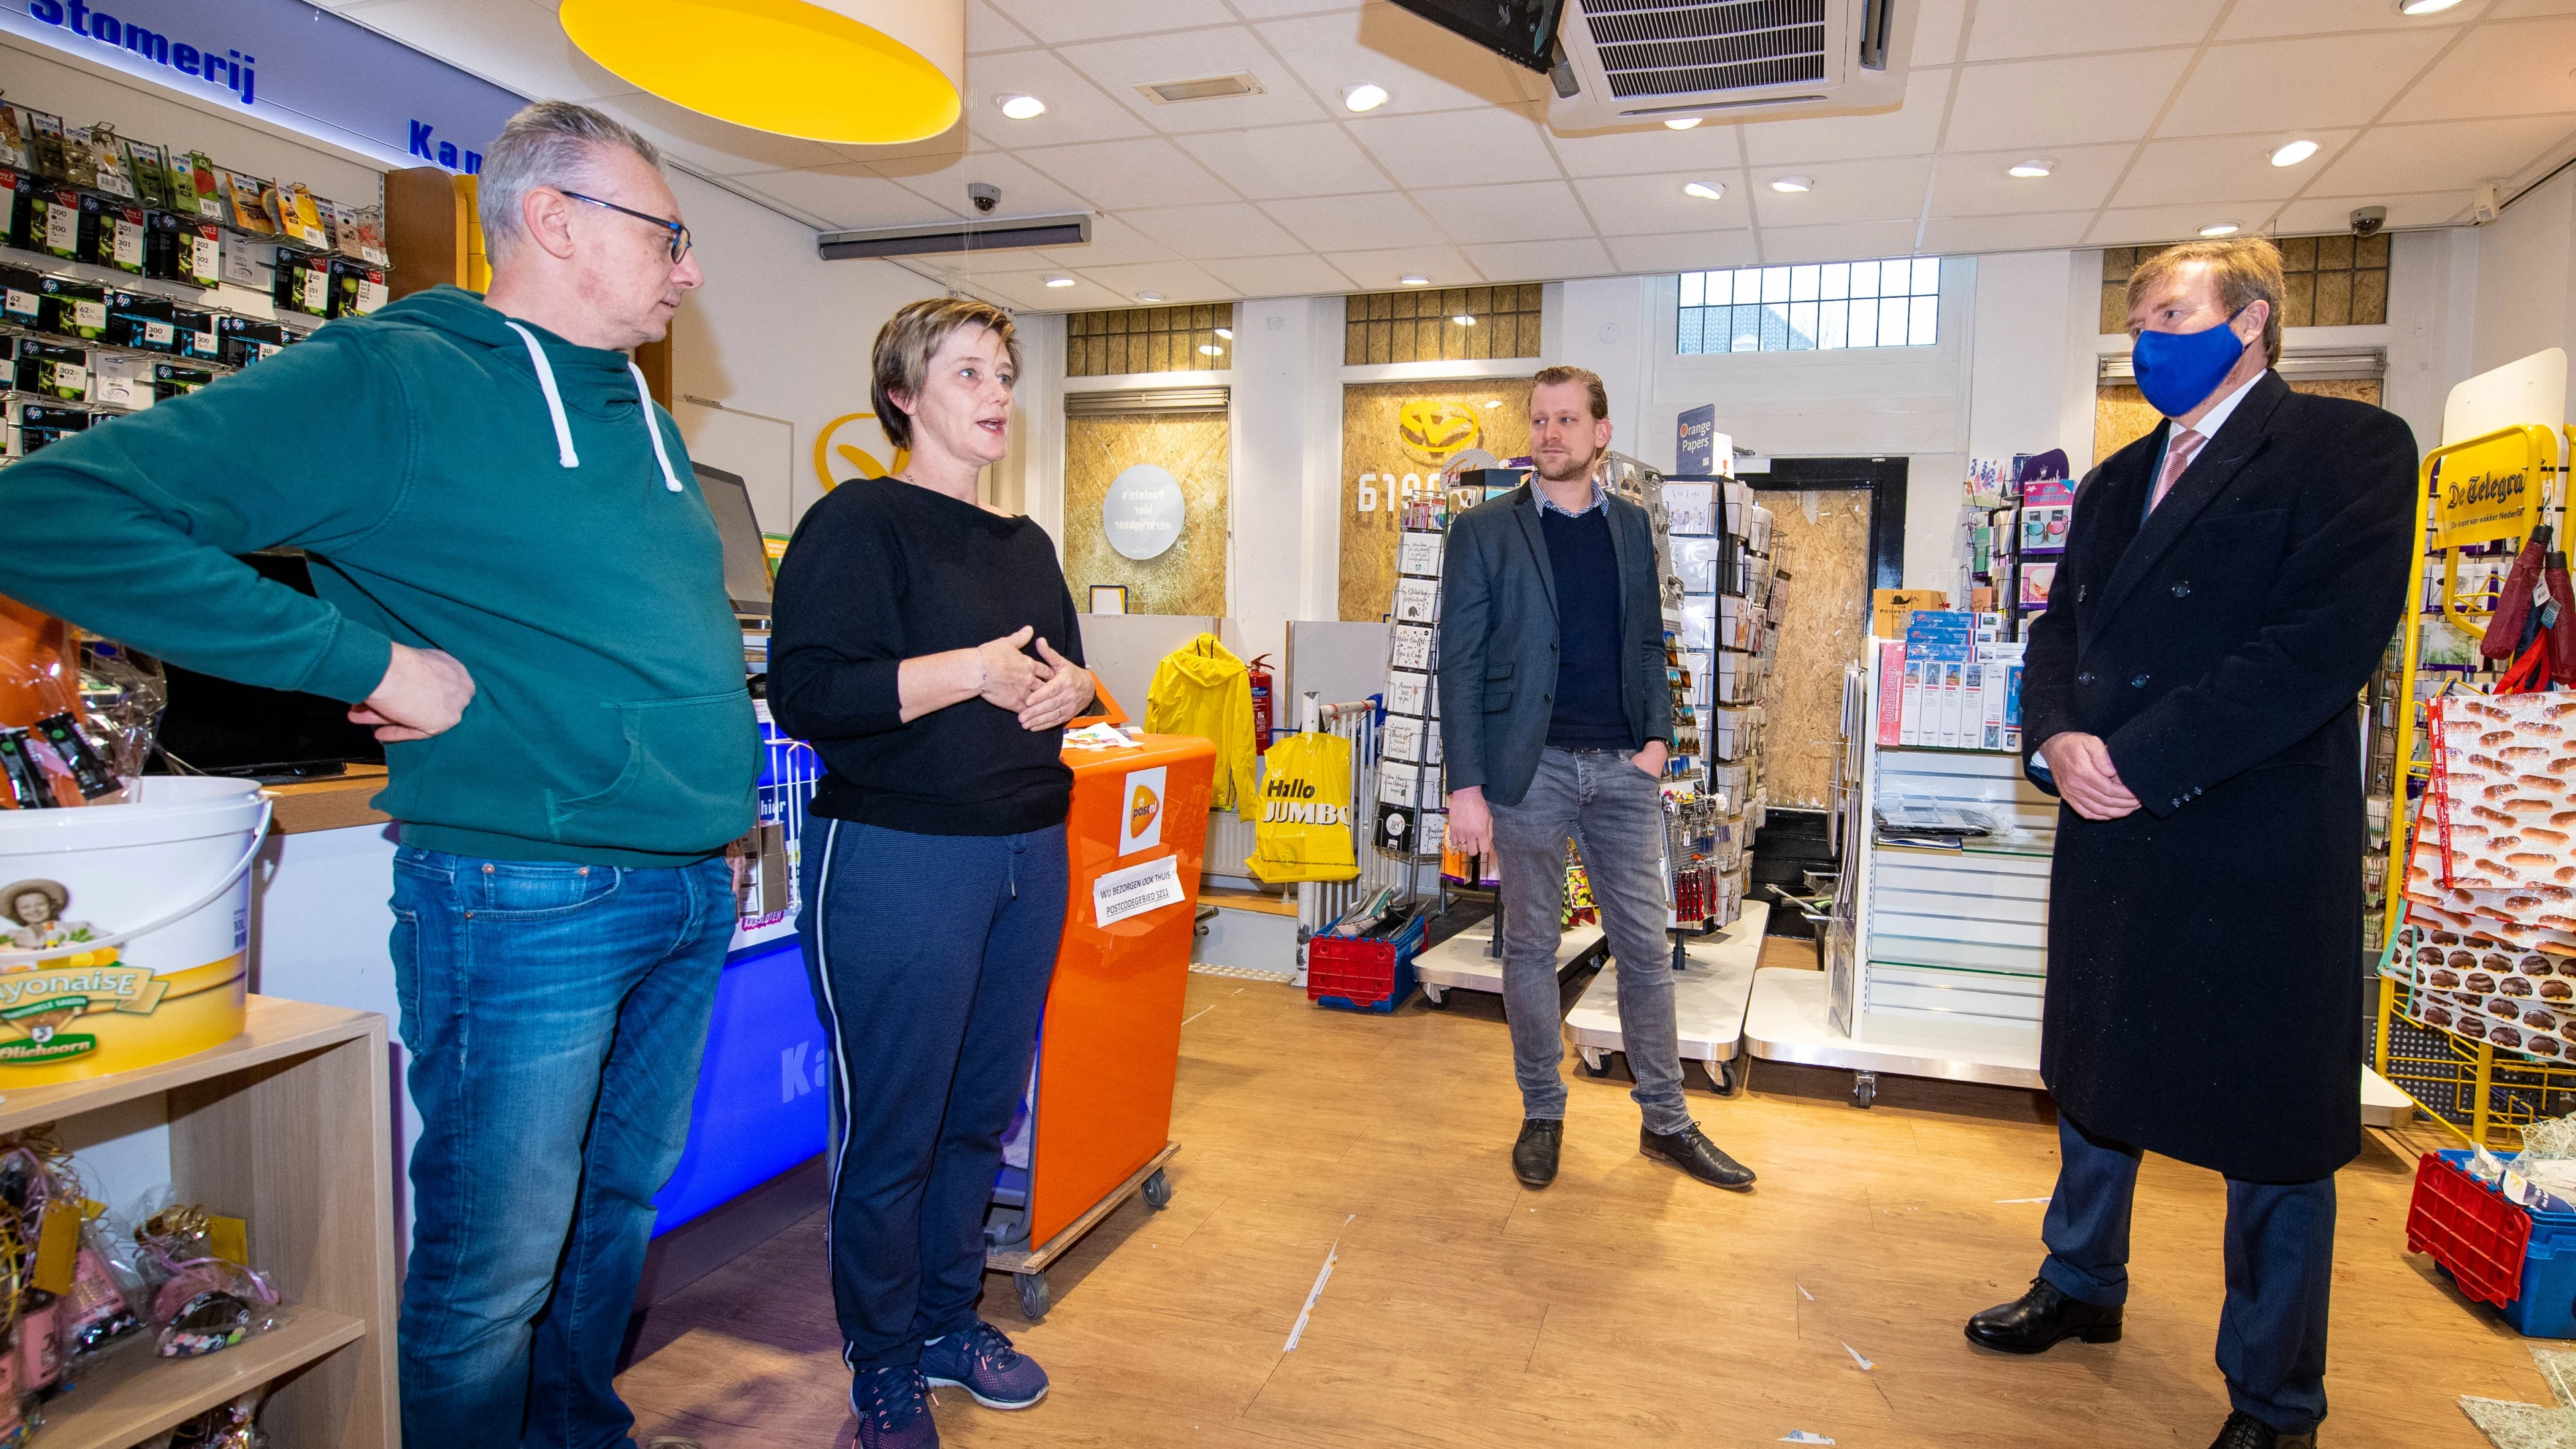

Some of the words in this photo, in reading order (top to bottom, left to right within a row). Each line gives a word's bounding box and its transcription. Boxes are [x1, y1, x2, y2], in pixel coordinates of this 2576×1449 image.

[29, 0, 255, 105] Stomerij
[66, 127, 89, 139] EPSON
[133, 148, 156, 158] EPSON
[172, 155, 191, 165] EPSON
[16, 180, 30, 193] hp
[235, 177, 255, 187] EPSON
[85, 198, 98, 211] hp
[52, 207, 66, 217] 300
[337, 209, 354, 218] EPSON
[163, 216, 176, 227] hp
[51, 224, 66, 233] 300
[119, 224, 131, 232] 301
[118, 239, 130, 248] 301
[196, 241, 209, 249] 302
[280, 250, 290, 260] hp
[334, 264, 344, 274] hp
[43, 280, 58, 292] hp
[117, 295, 130, 307] hp
[233, 319, 244, 329] hp
[24, 343, 38, 354] hp
[159, 367, 171, 378] hp
[28, 407, 42, 419] hp
[1680, 421, 1711, 438] Orange
[1682, 437, 1709, 454] Papers
[2043, 486, 2059, 494] EEN
[2447, 482, 2465, 510] De
[2467, 471, 2525, 505] Telegra
[2458, 519, 2469, 527] krant
[2479, 514, 2499, 523] wakker
[2499, 508, 2523, 520] Nederla
[1886, 665, 1898, 688] Duck
[1884, 689, 1895, 723] Donald
[1268, 779, 1316, 799] Hallo
[1133, 801, 1157, 821] postnl
[1101, 884, 1112, 899] WIJ
[1112, 878, 1142, 898] BEZORGEN
[1142, 875, 1154, 887] OOK
[1155, 871, 1171, 883] THUIS
[1106, 892, 1155, 915] POSTCODEGEBIED
[1157, 888, 1169, 901] 5211
